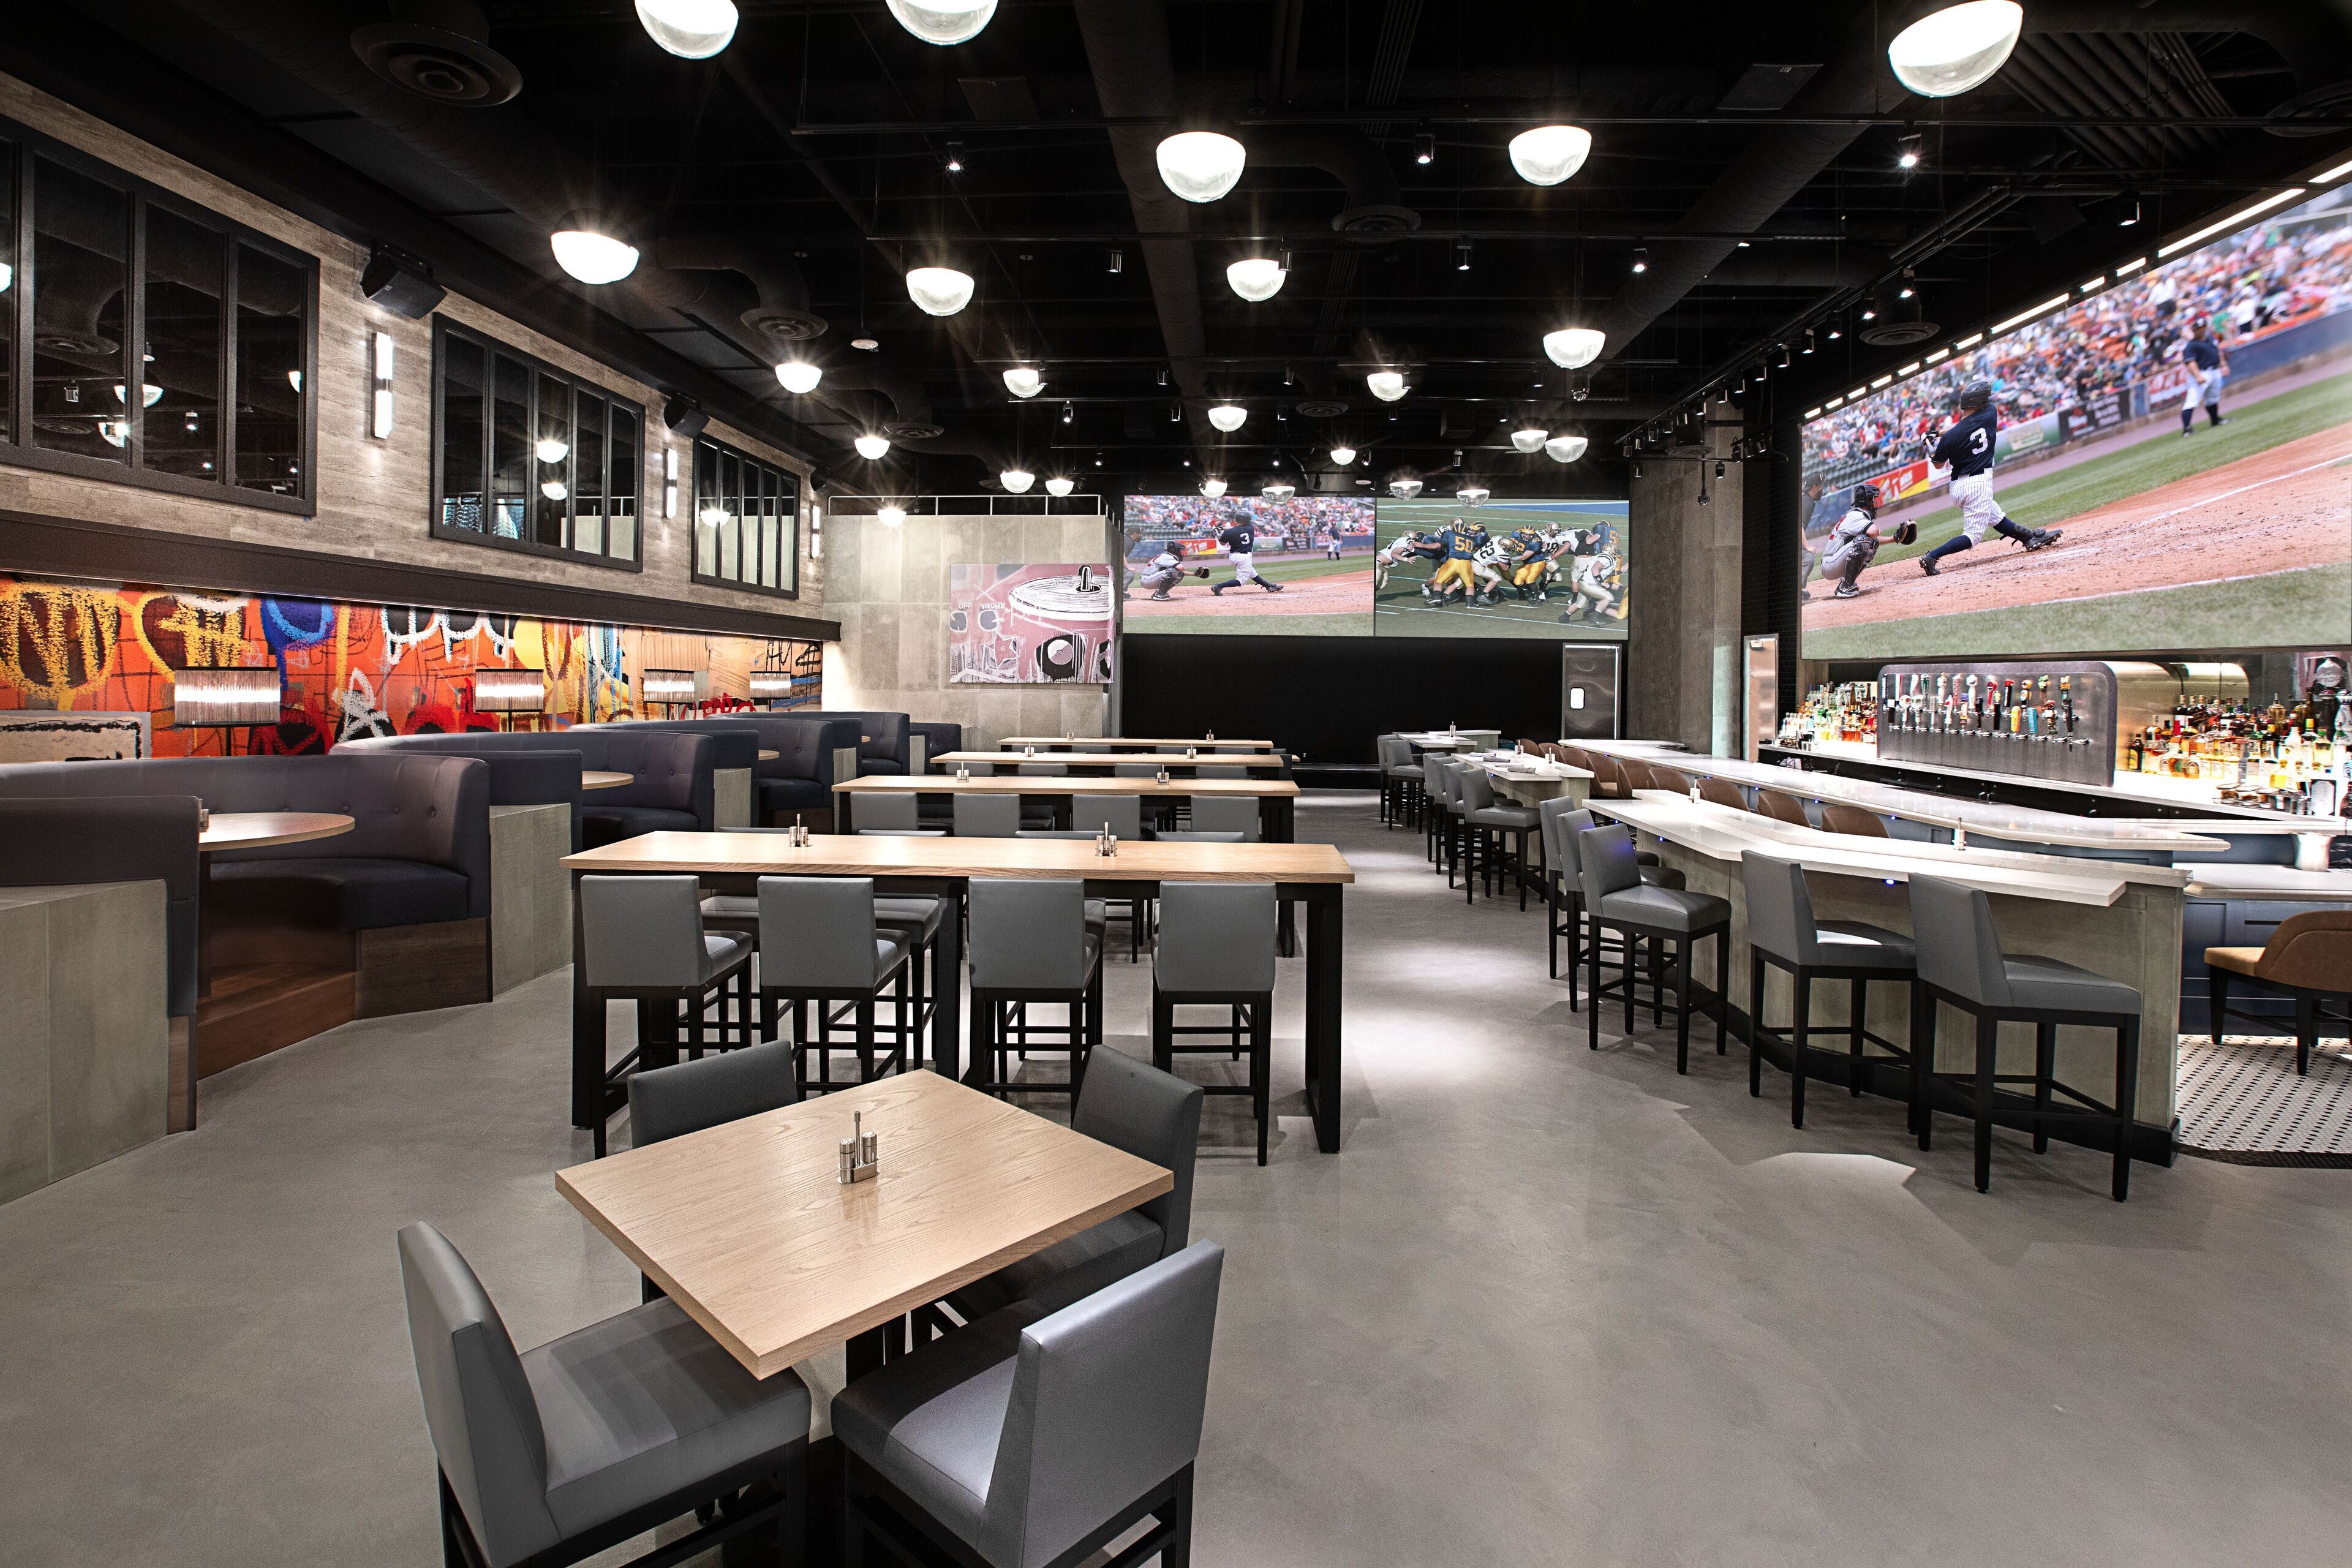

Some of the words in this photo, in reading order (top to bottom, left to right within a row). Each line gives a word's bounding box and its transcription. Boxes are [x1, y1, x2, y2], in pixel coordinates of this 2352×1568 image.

[1969, 428, 1988, 454] 3
[1240, 532, 1250, 544] 3
[1454, 535, 1473, 553] 50
